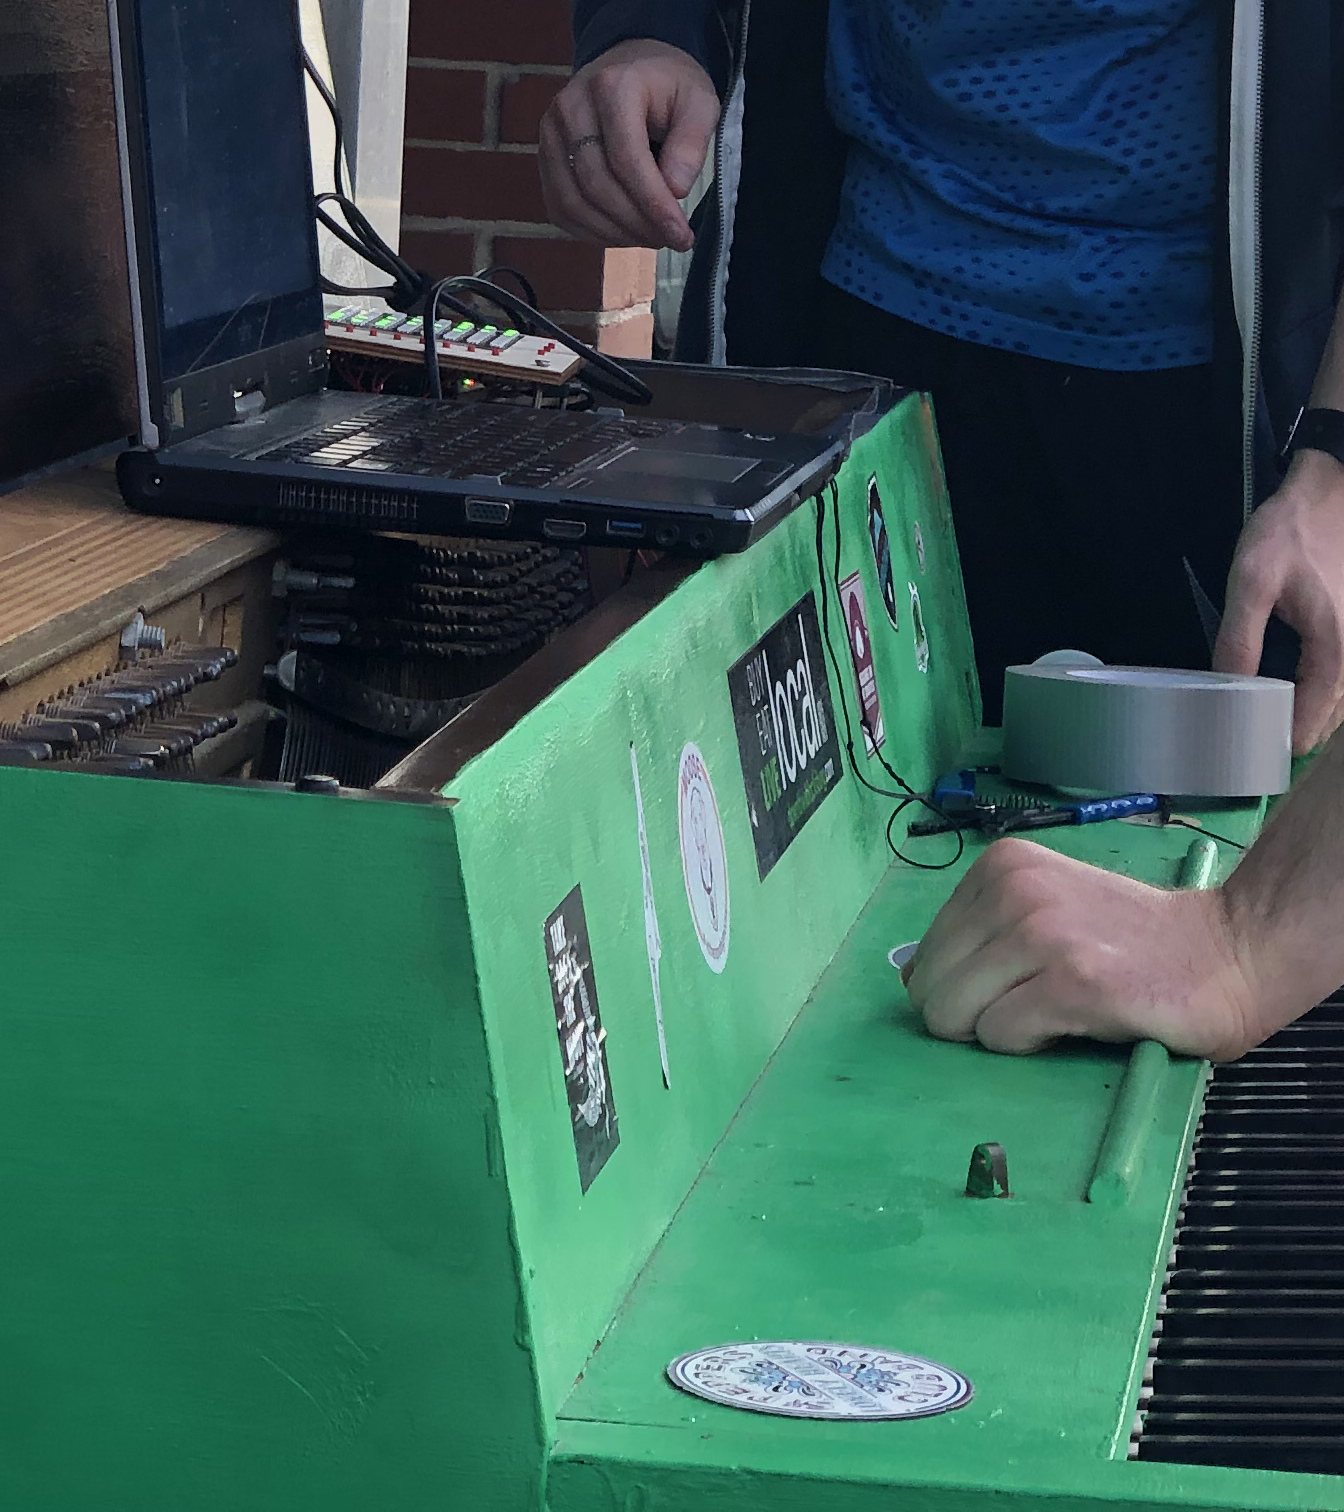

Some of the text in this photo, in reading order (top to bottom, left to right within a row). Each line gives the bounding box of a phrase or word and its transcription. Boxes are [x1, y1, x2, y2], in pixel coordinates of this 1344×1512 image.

[746, 654, 765, 706] BUY
[762, 613, 823, 791] local
[756, 703, 773, 757] EAT
